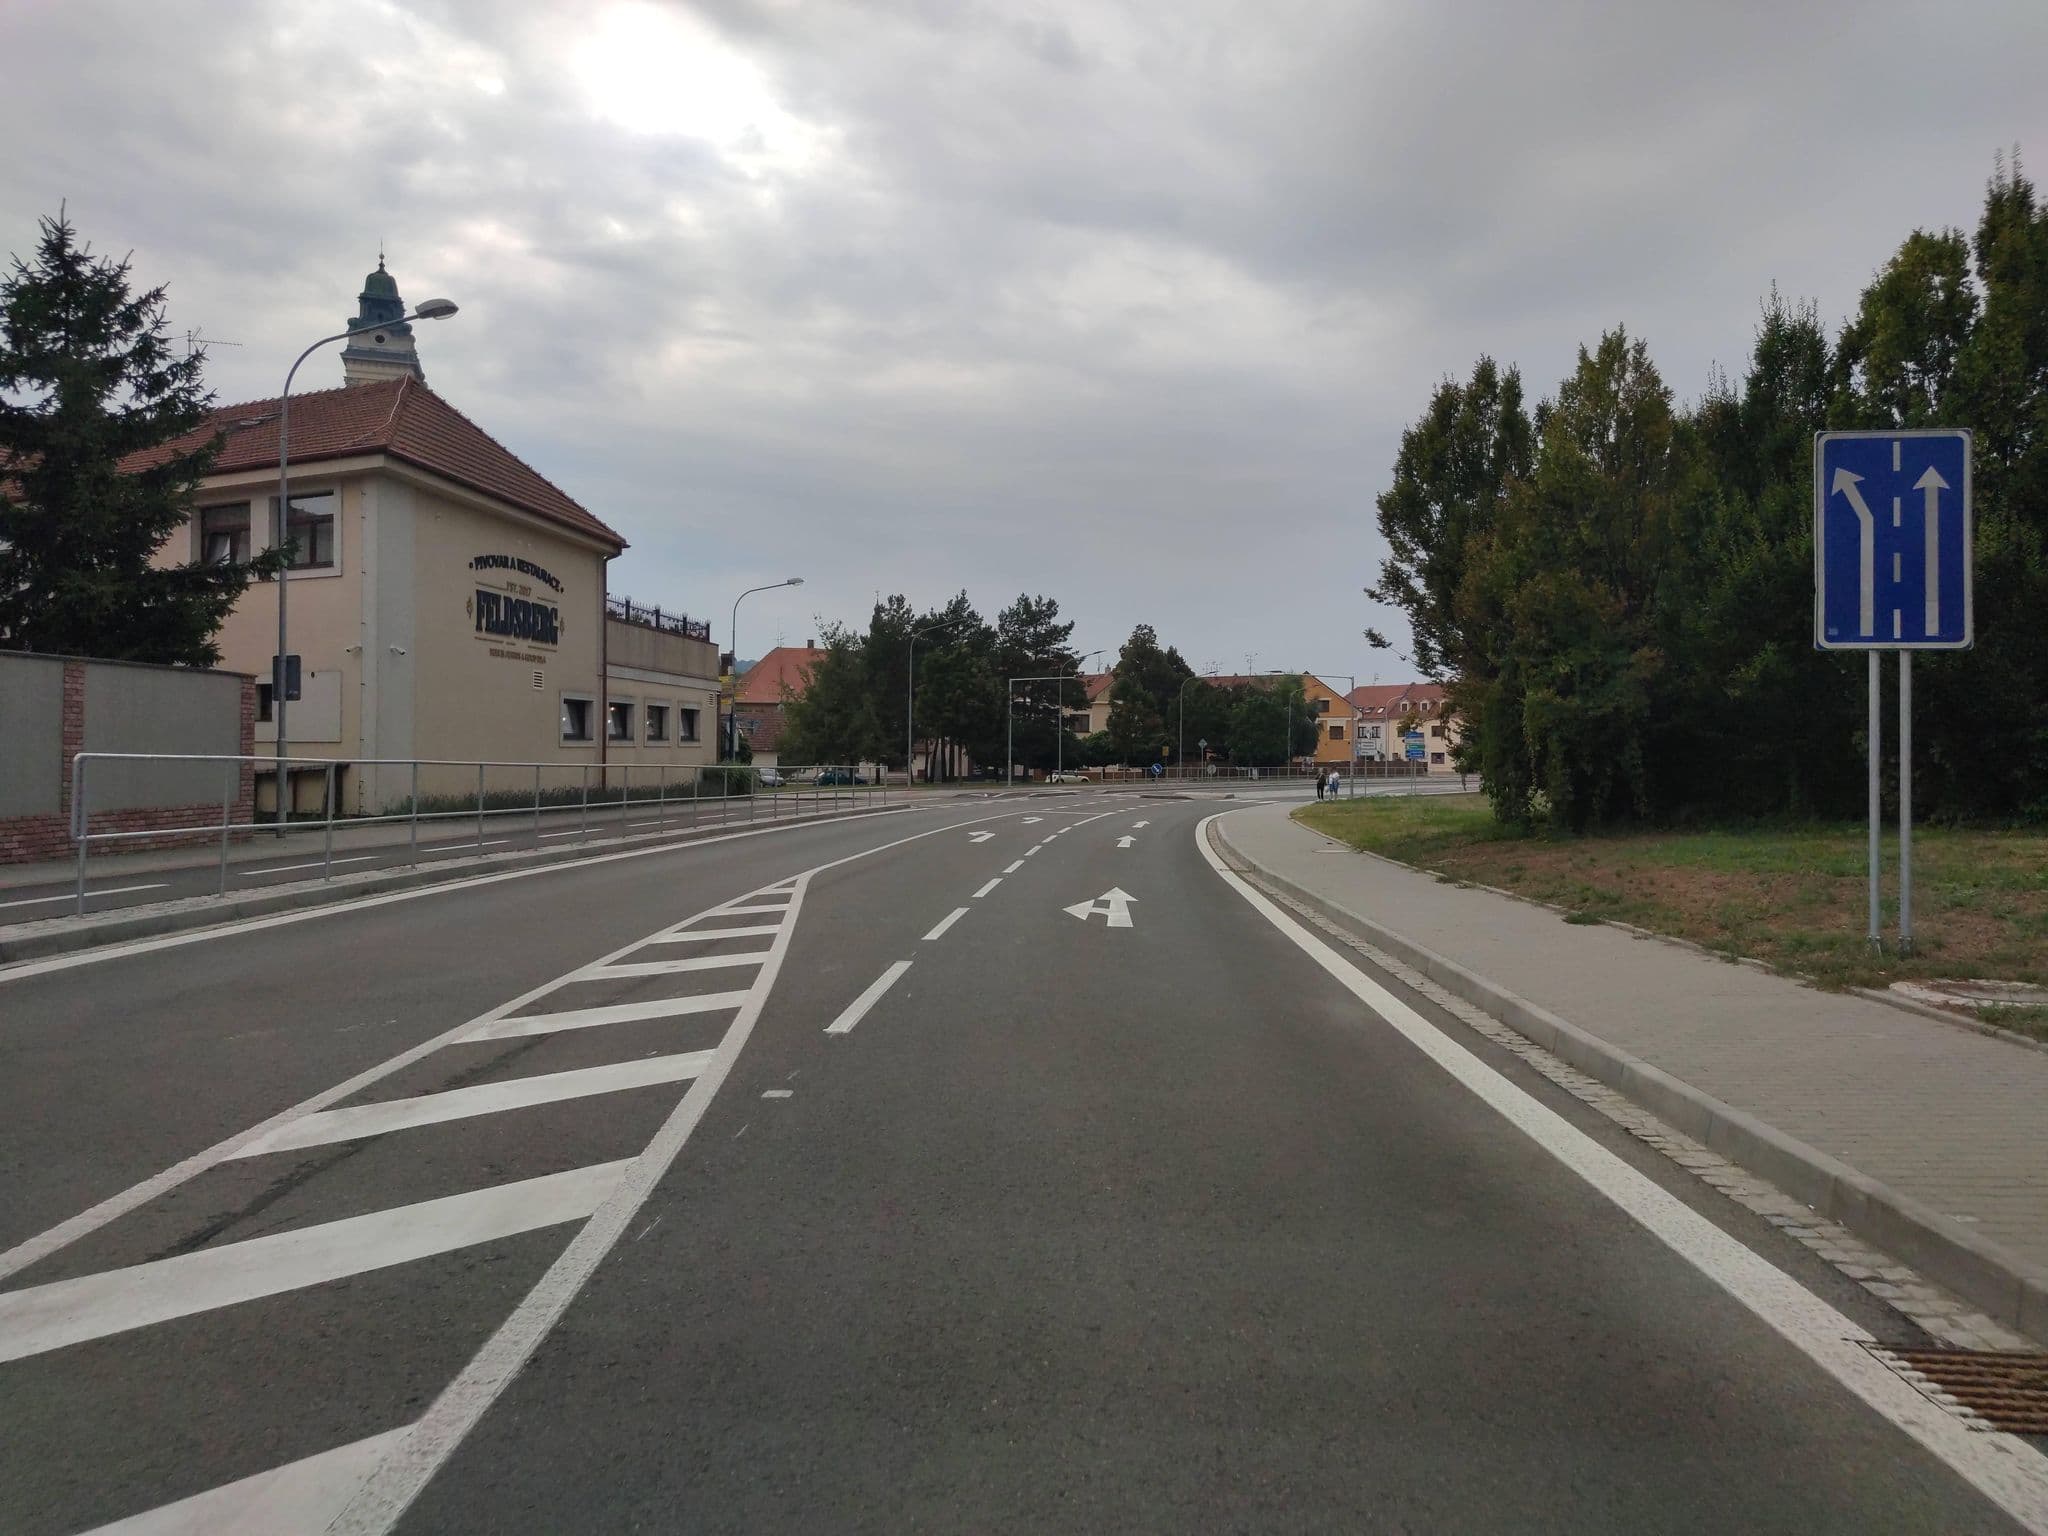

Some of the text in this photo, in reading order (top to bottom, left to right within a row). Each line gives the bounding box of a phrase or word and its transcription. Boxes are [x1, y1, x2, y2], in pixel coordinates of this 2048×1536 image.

[474, 555, 560, 592] PIVOVAR A RESTAURACE
[476, 589, 559, 646] FELDSBERG
